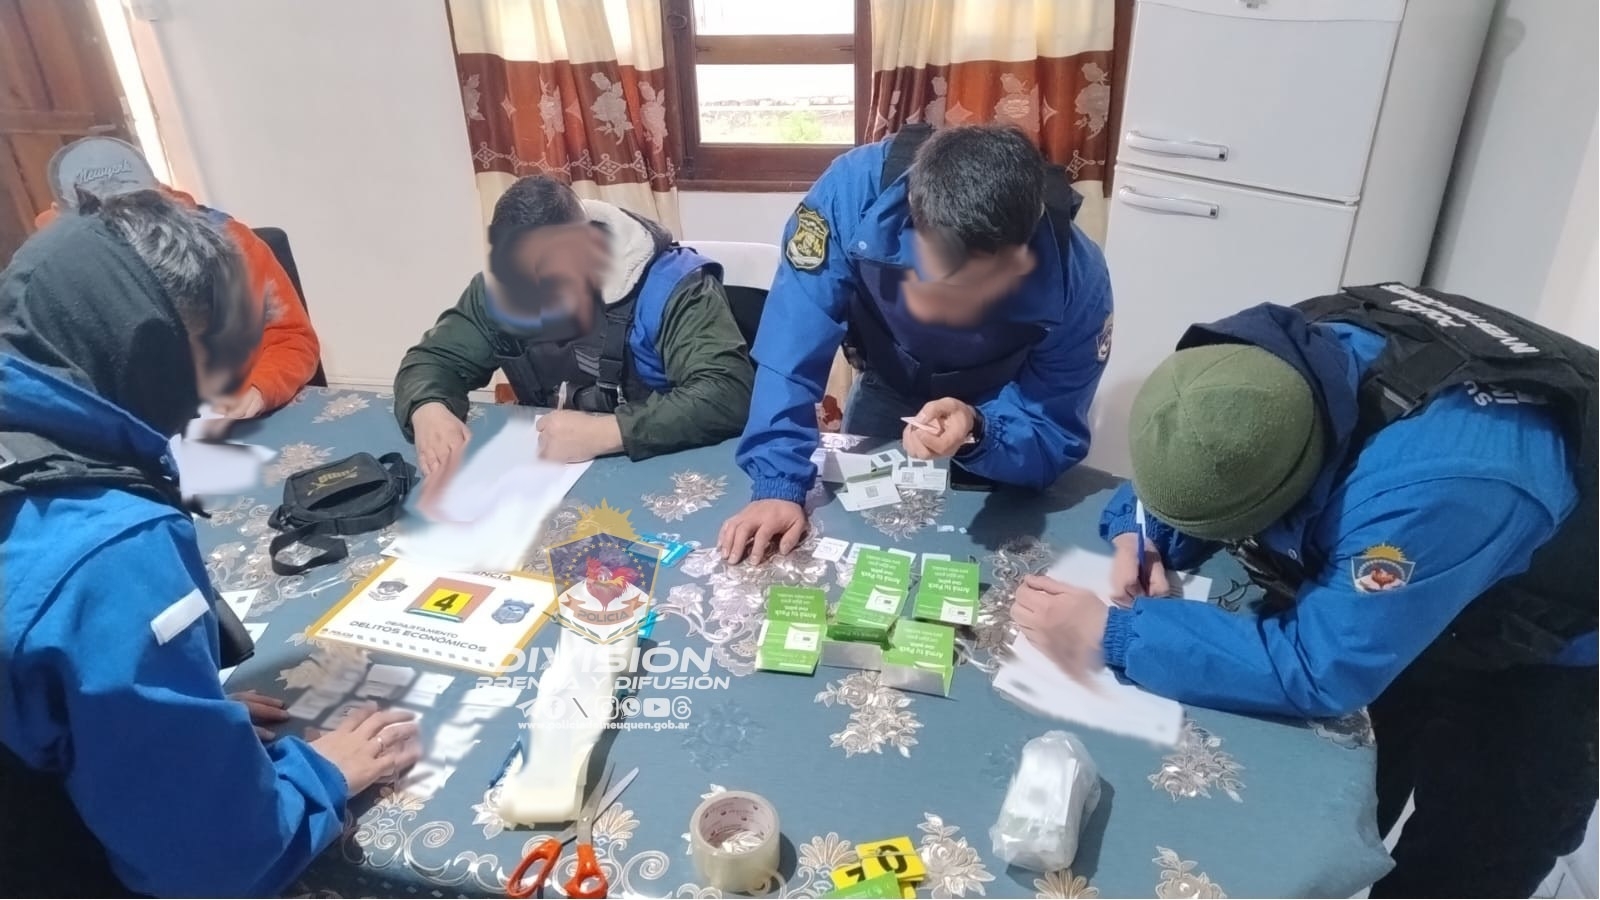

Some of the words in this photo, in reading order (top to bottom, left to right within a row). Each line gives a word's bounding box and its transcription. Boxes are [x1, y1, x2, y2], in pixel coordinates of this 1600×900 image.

[433, 593, 460, 612] 4
[349, 620, 400, 635] DELITOS
[402, 630, 488, 653] ECONÓMICOS
[384, 620, 459, 639] DEPARTAMENTO
